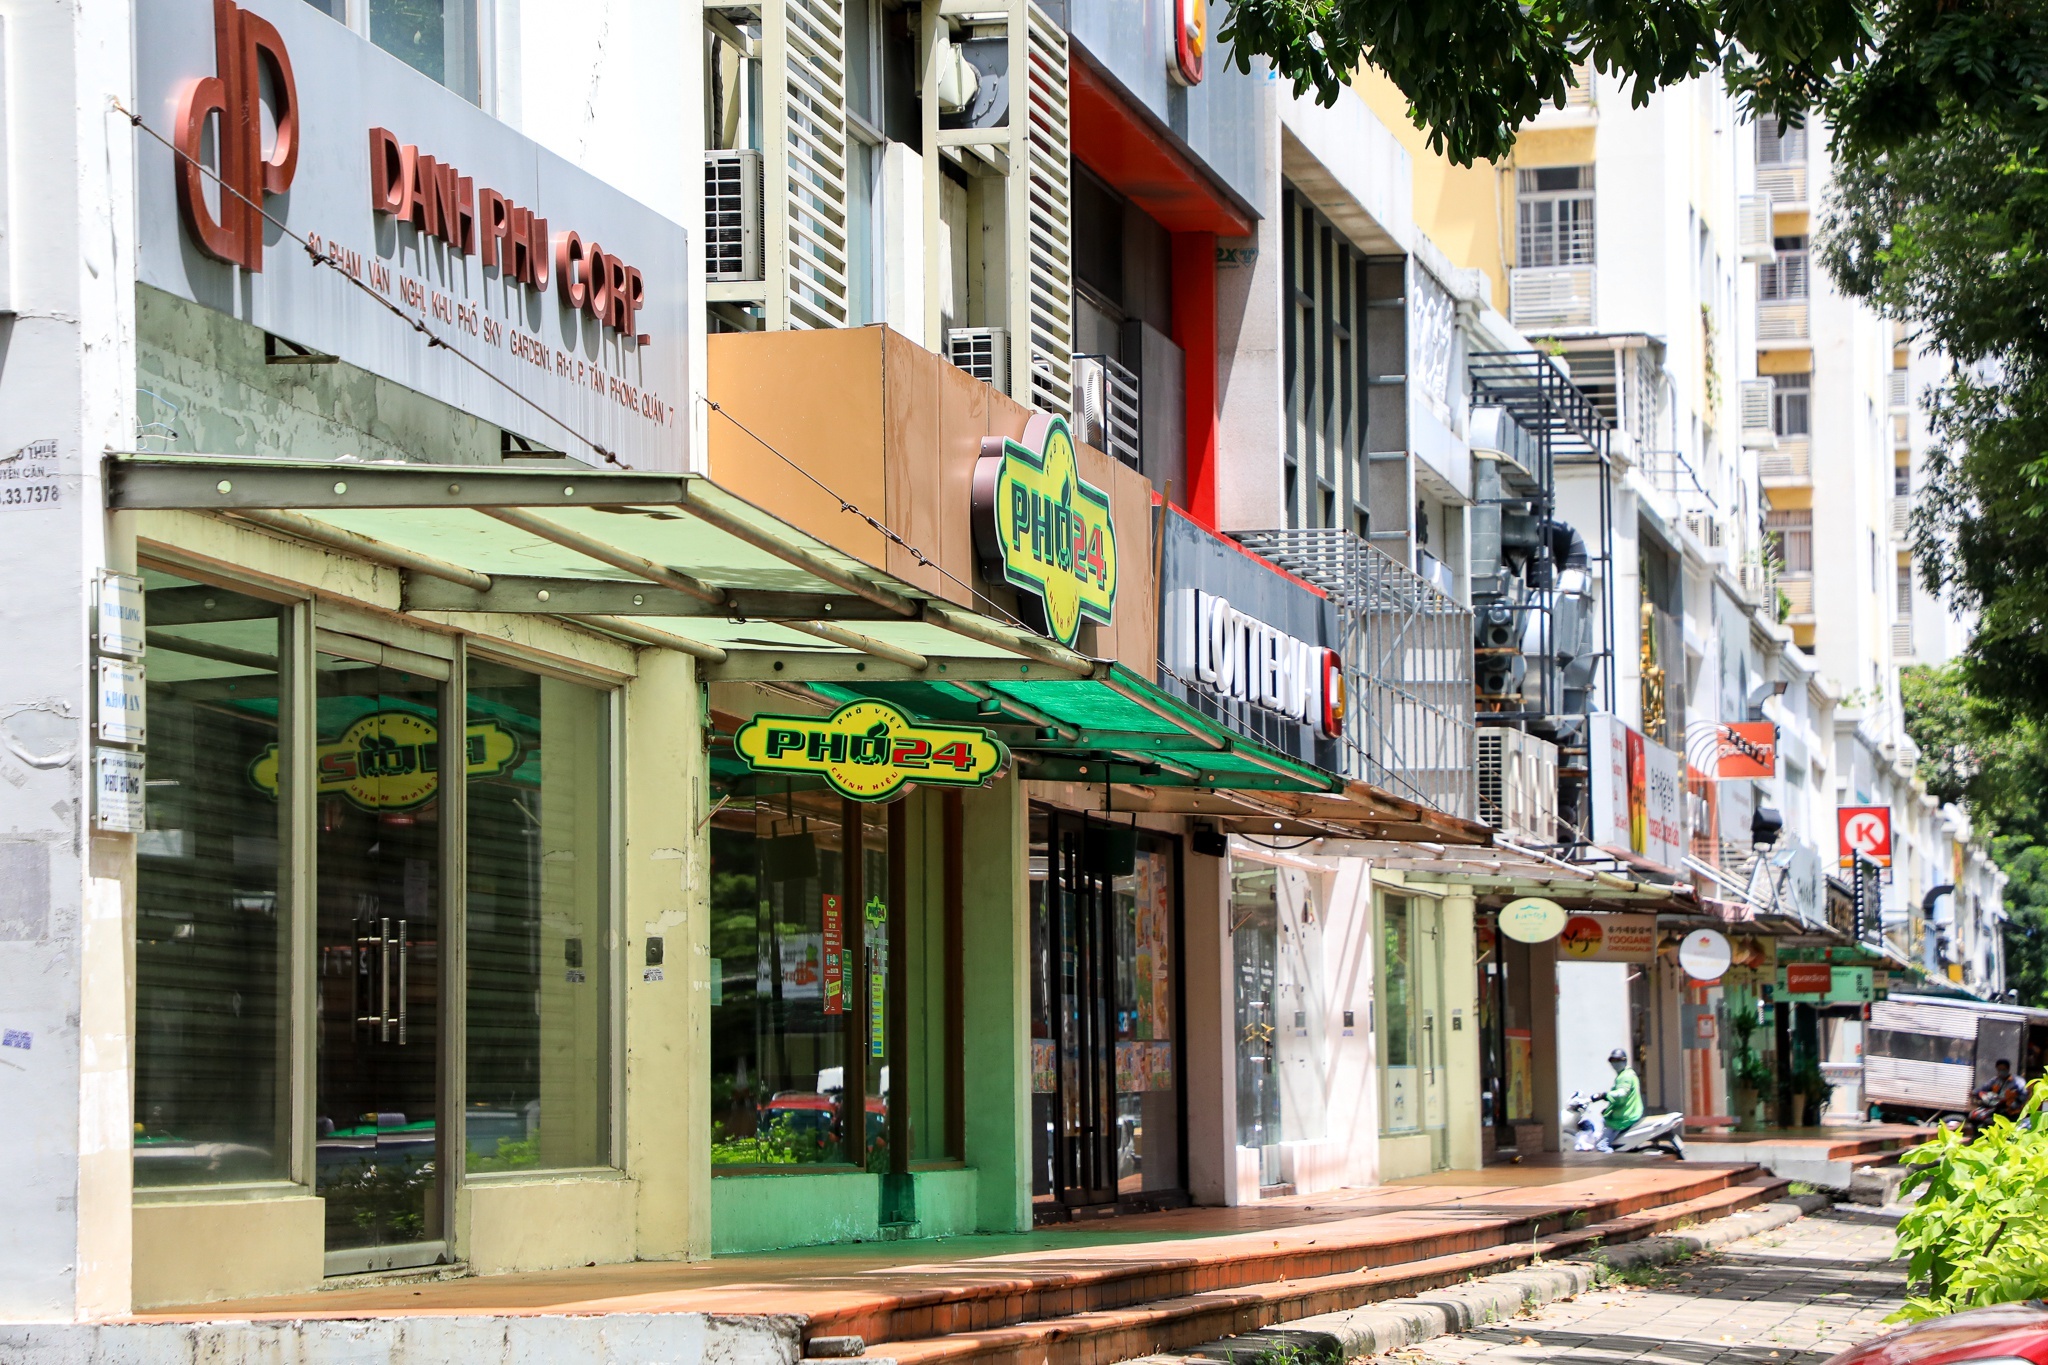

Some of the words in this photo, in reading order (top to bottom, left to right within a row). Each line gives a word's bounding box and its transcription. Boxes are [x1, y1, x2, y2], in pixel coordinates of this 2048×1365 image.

[369, 127, 475, 255] DANH
[479, 187, 550, 292] PHU
[368, 256, 390, 295] VĂN
[432, 290, 452, 325] KHU
[457, 301, 478, 337] PHỐ
[484, 316, 502, 348] SKY
[589, 361, 605, 396] TÂN
[610, 376, 640, 416] PHONG,
[641, 390, 664, 428] QUẬN
[669, 406, 674, 429] 7
[0, 485, 59, 505] .33.7378
[831, 766, 864, 792] CHÍNH
[1607, 935, 1652, 944] YOOGANE
